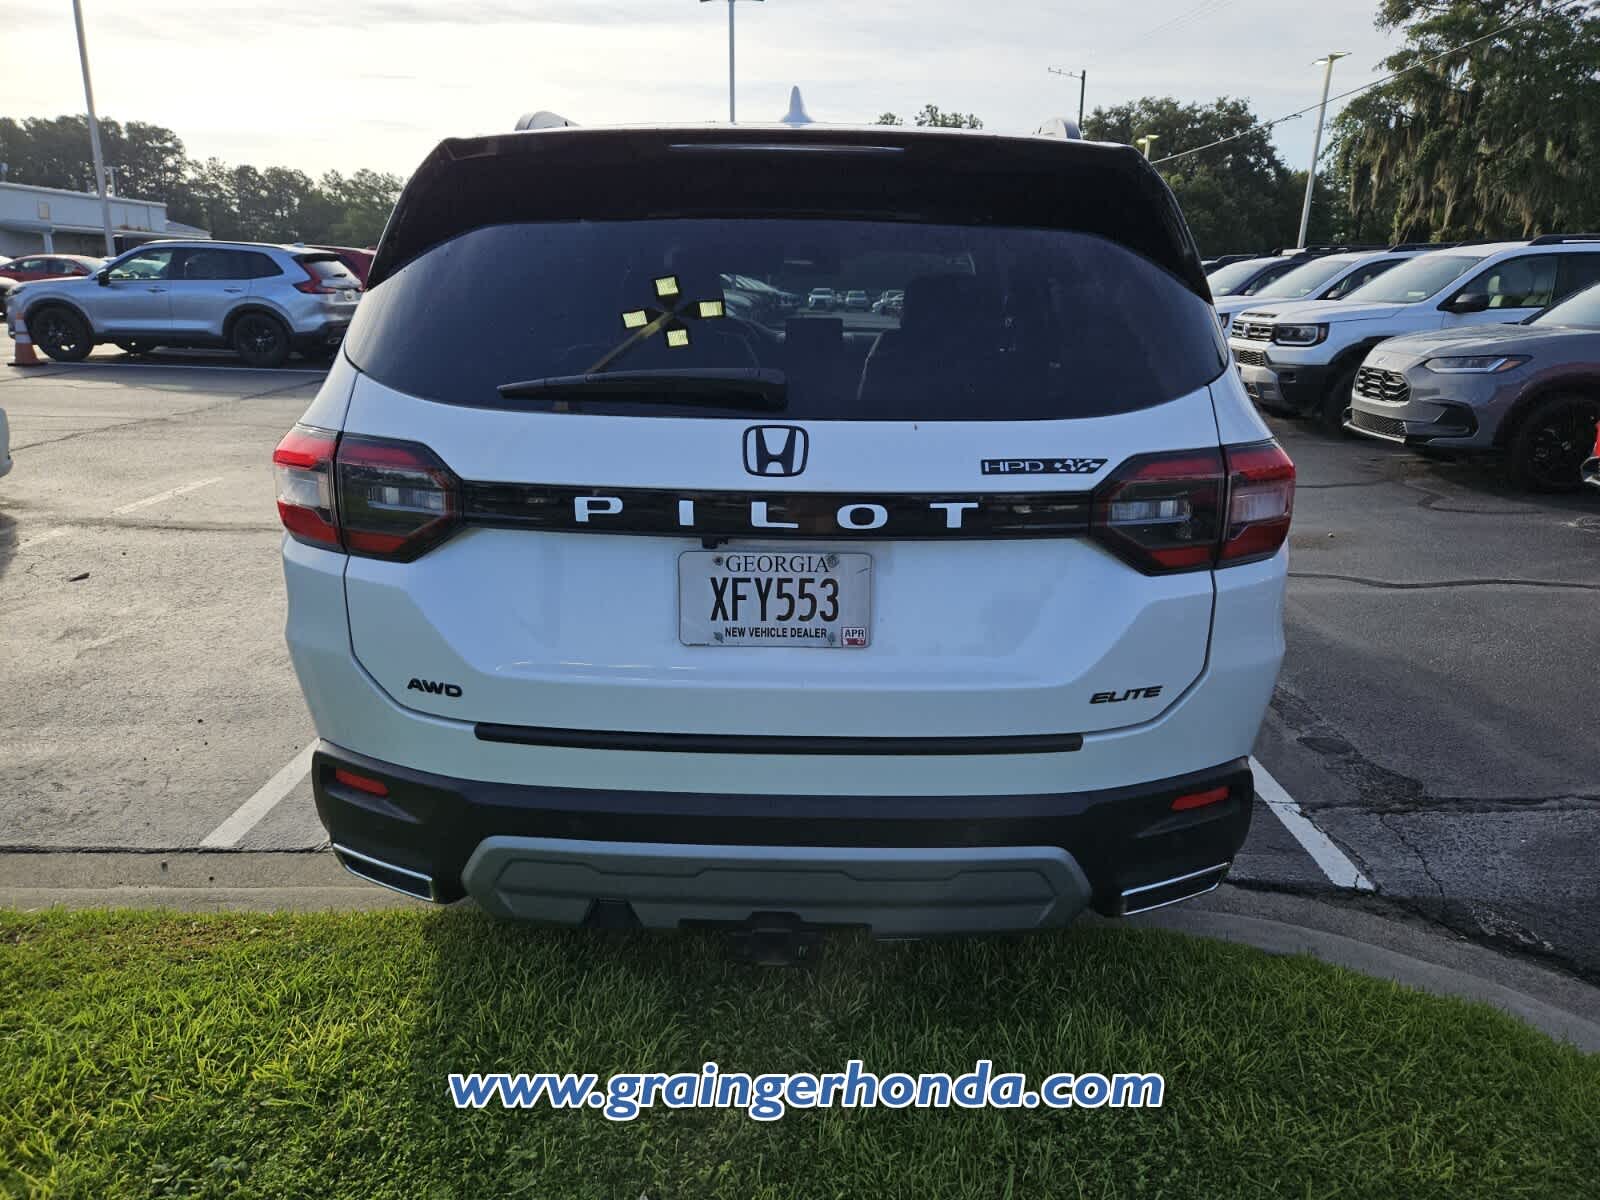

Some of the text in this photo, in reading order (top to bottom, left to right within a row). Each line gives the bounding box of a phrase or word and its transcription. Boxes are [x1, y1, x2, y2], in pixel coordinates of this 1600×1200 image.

[984, 460, 1044, 472] HPD
[574, 495, 978, 530] PILOT
[725, 555, 829, 572] GEORGIA
[710, 577, 839, 622] XFY553
[725, 627, 827, 638] NEW VEHICLE DEALER
[845, 629, 864, 637] APR
[407, 678, 462, 697] AWD
[1089, 685, 1163, 704] ELITE
